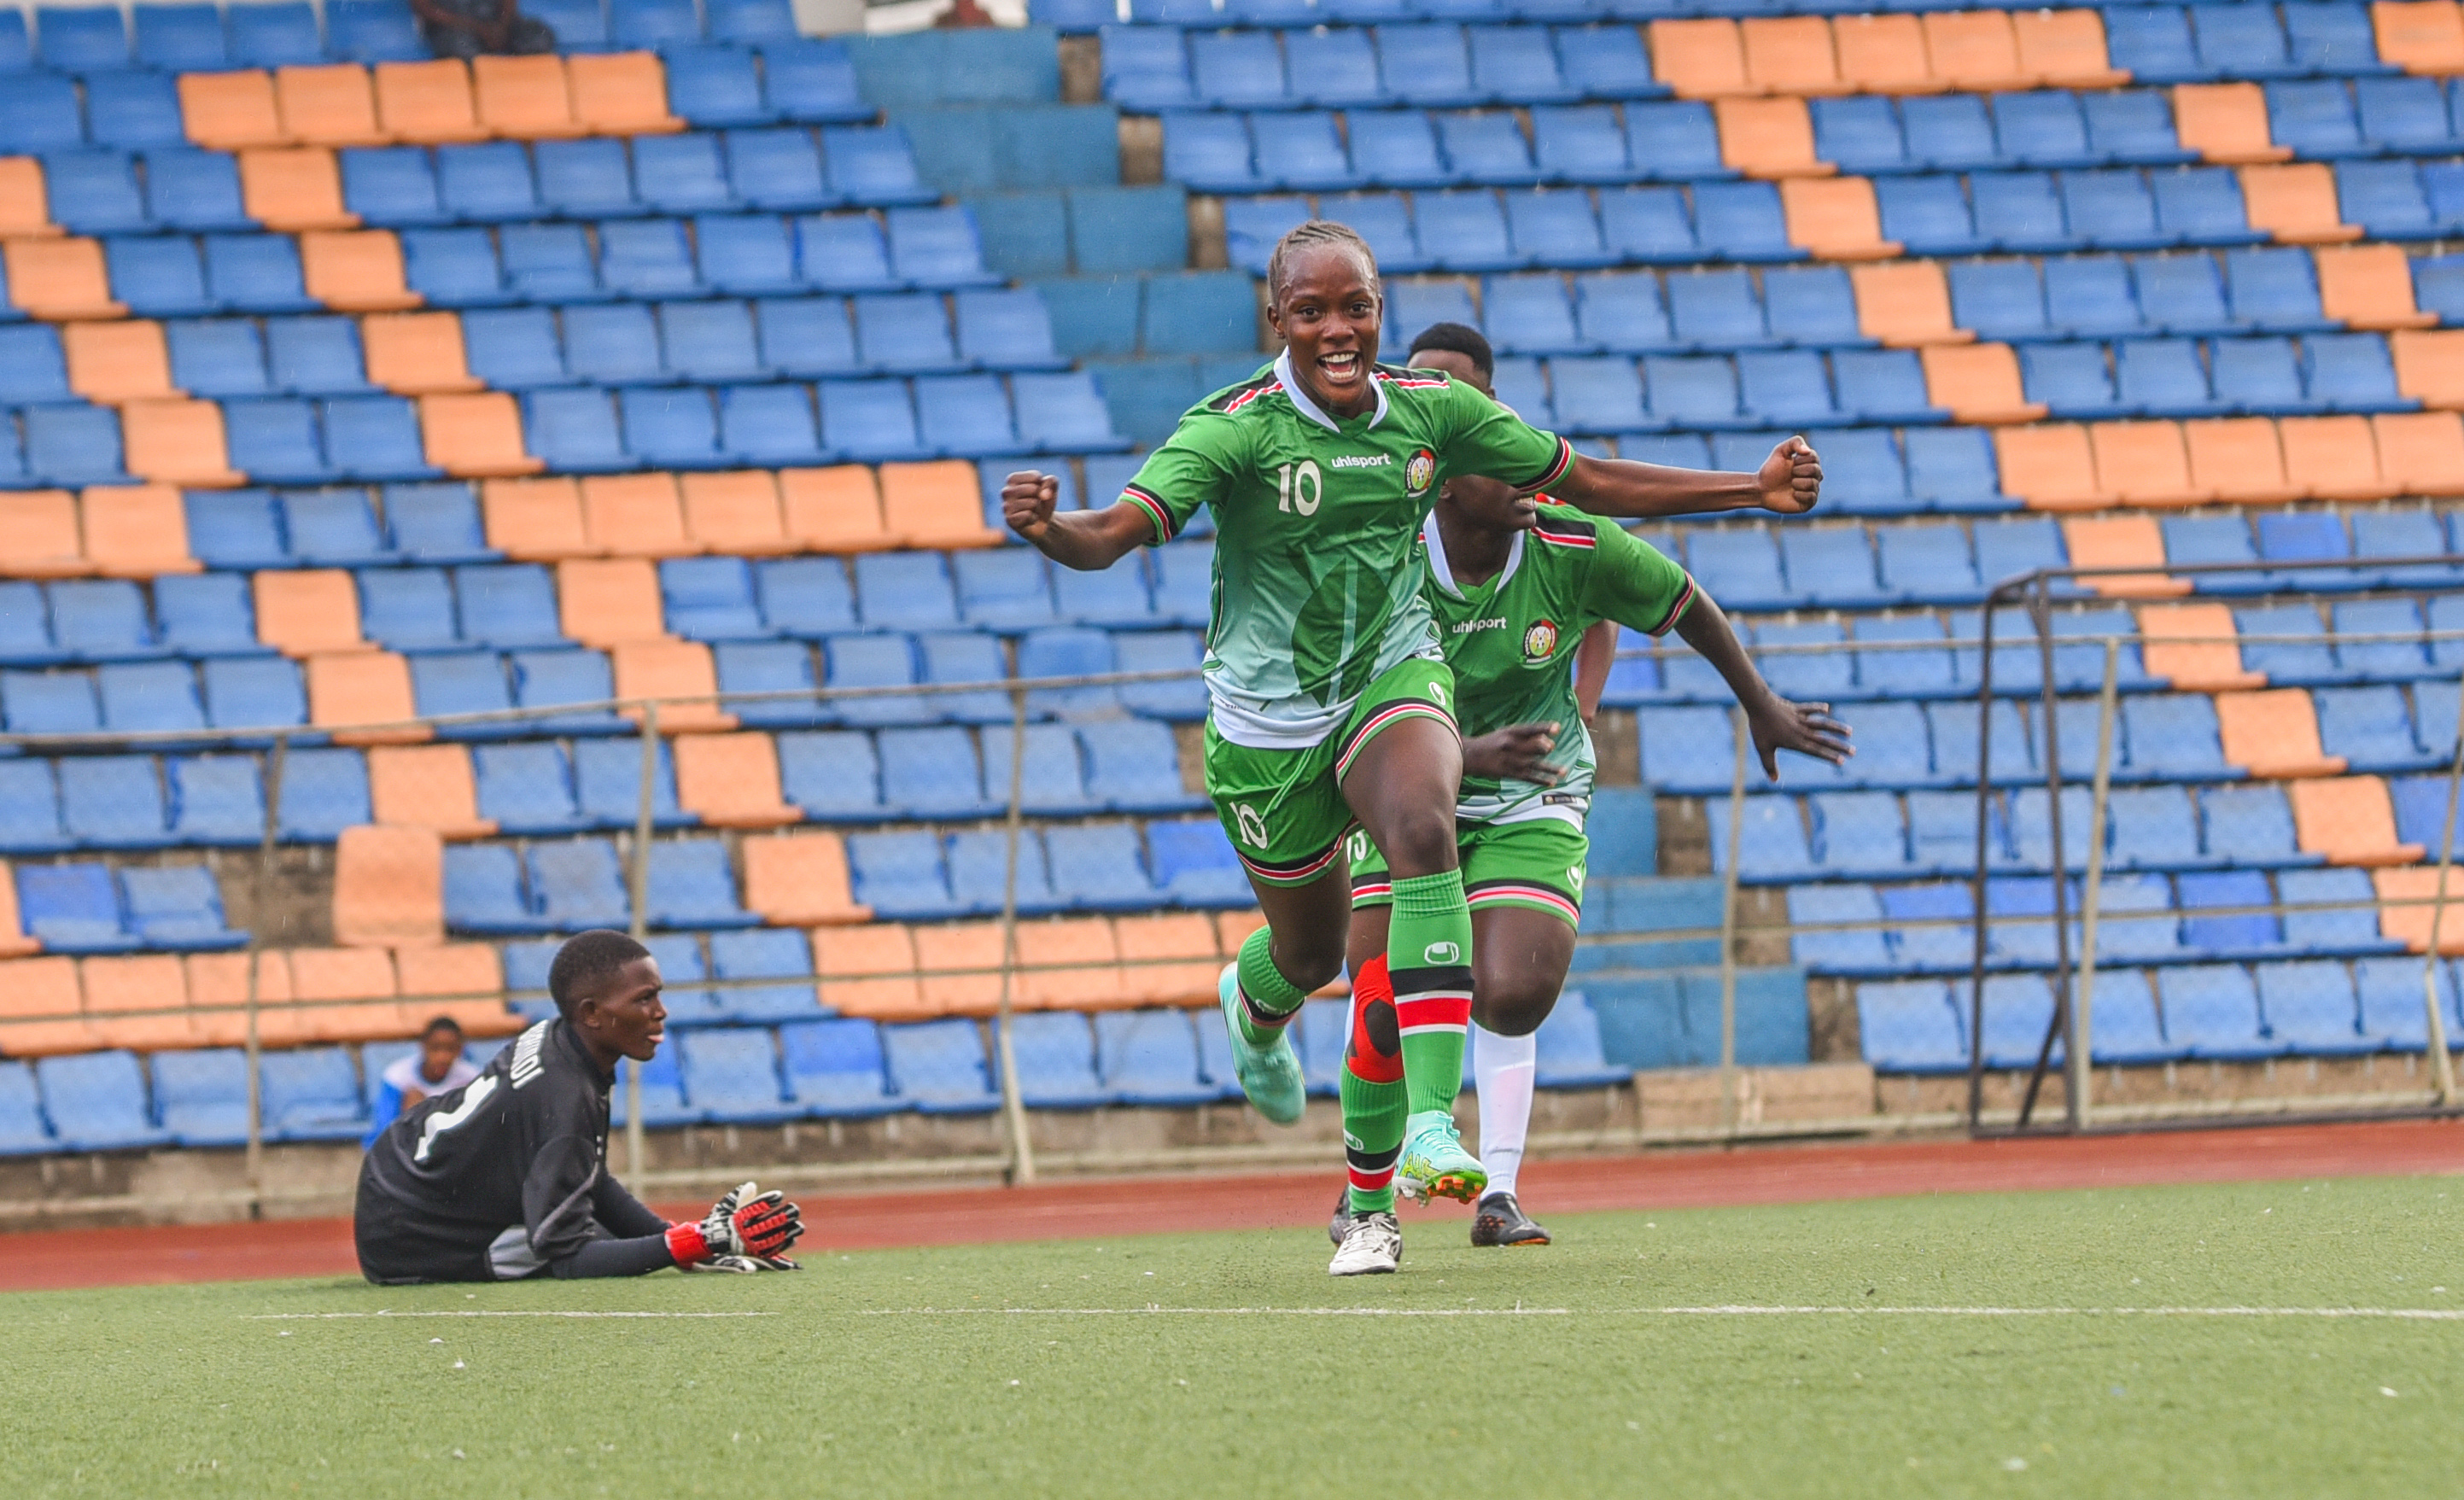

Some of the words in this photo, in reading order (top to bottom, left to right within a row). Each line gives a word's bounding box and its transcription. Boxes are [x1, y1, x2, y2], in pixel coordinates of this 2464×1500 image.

[1332, 452, 1392, 468] uhlsport
[1277, 459, 1322, 517] 10
[1228, 801, 1268, 849] 10
